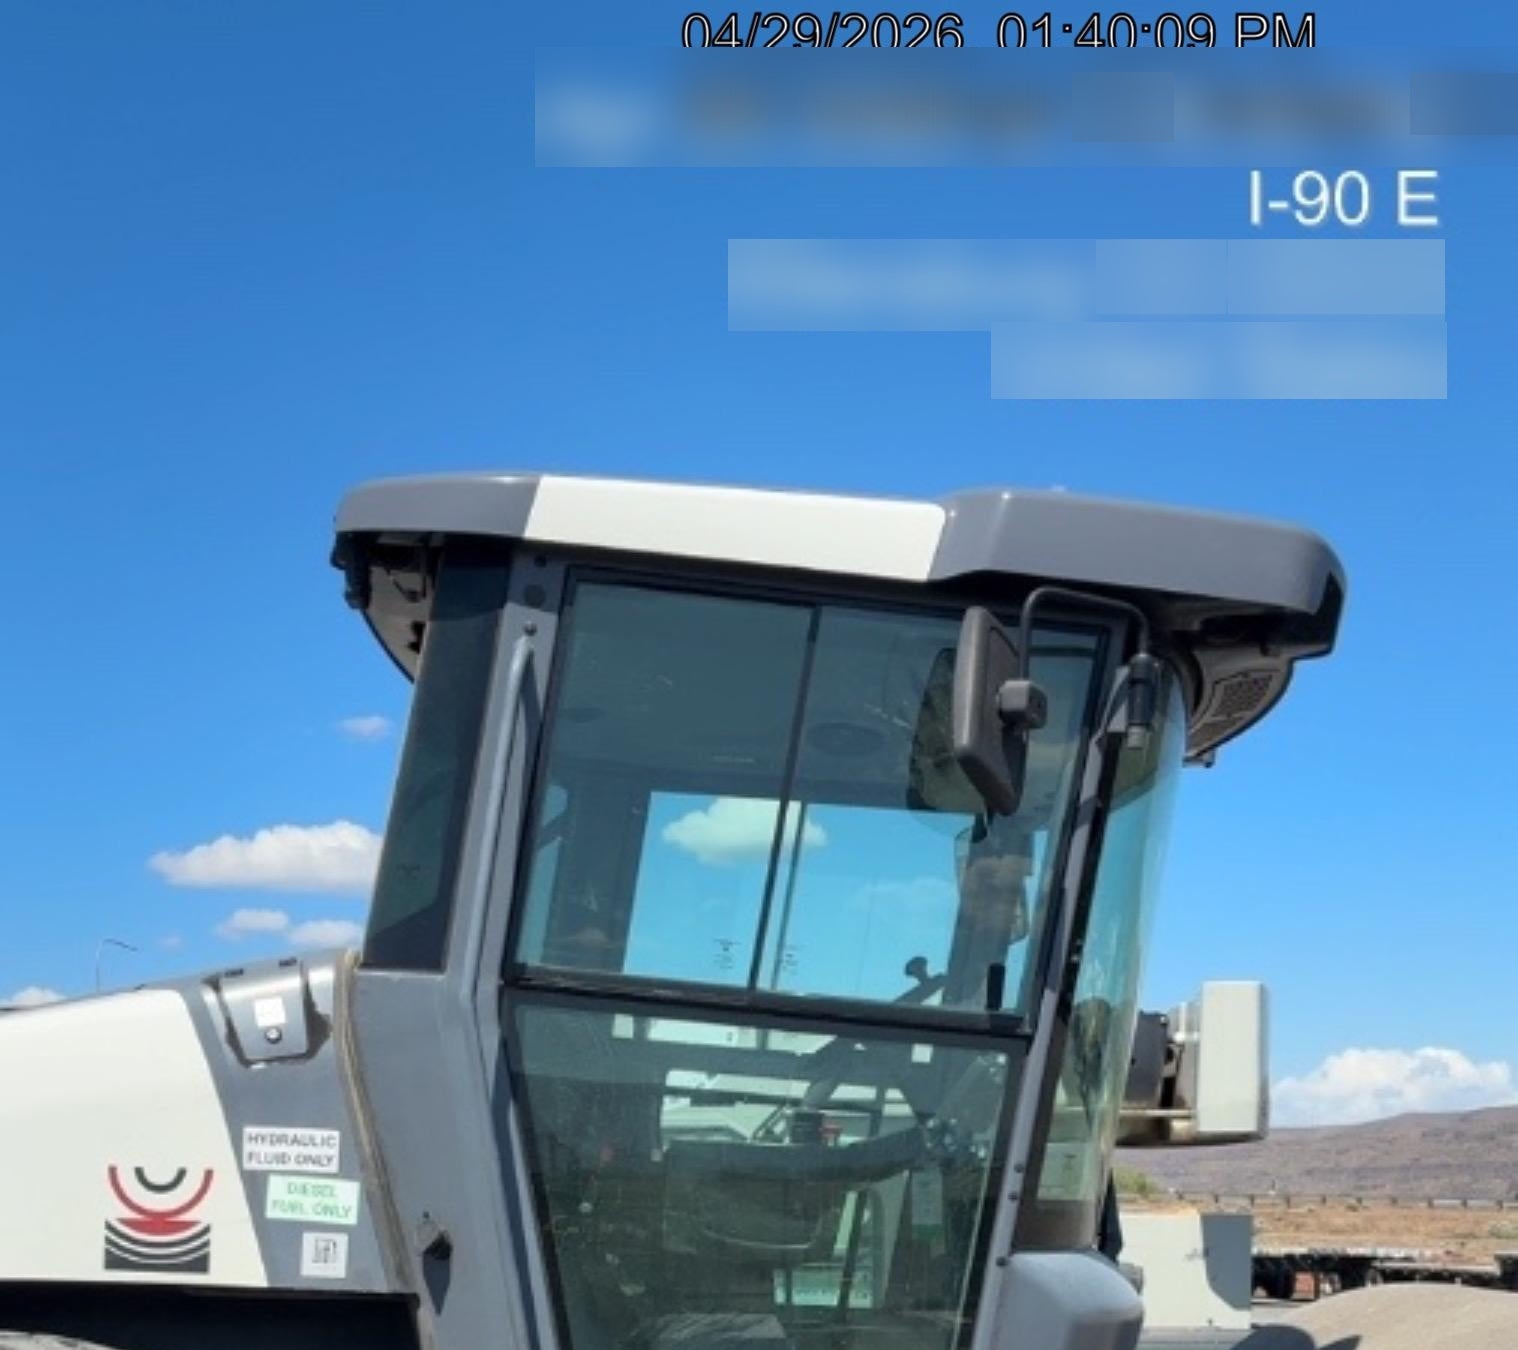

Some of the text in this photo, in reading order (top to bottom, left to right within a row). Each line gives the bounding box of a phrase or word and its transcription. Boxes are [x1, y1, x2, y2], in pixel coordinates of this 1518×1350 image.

[247, 1132, 338, 1149] HYDRAULIC
[247, 1151, 335, 1168] FLUID ONLY
[286, 1181, 337, 1199] DIESEL
[271, 1199, 353, 1219] FUEL ONLY
